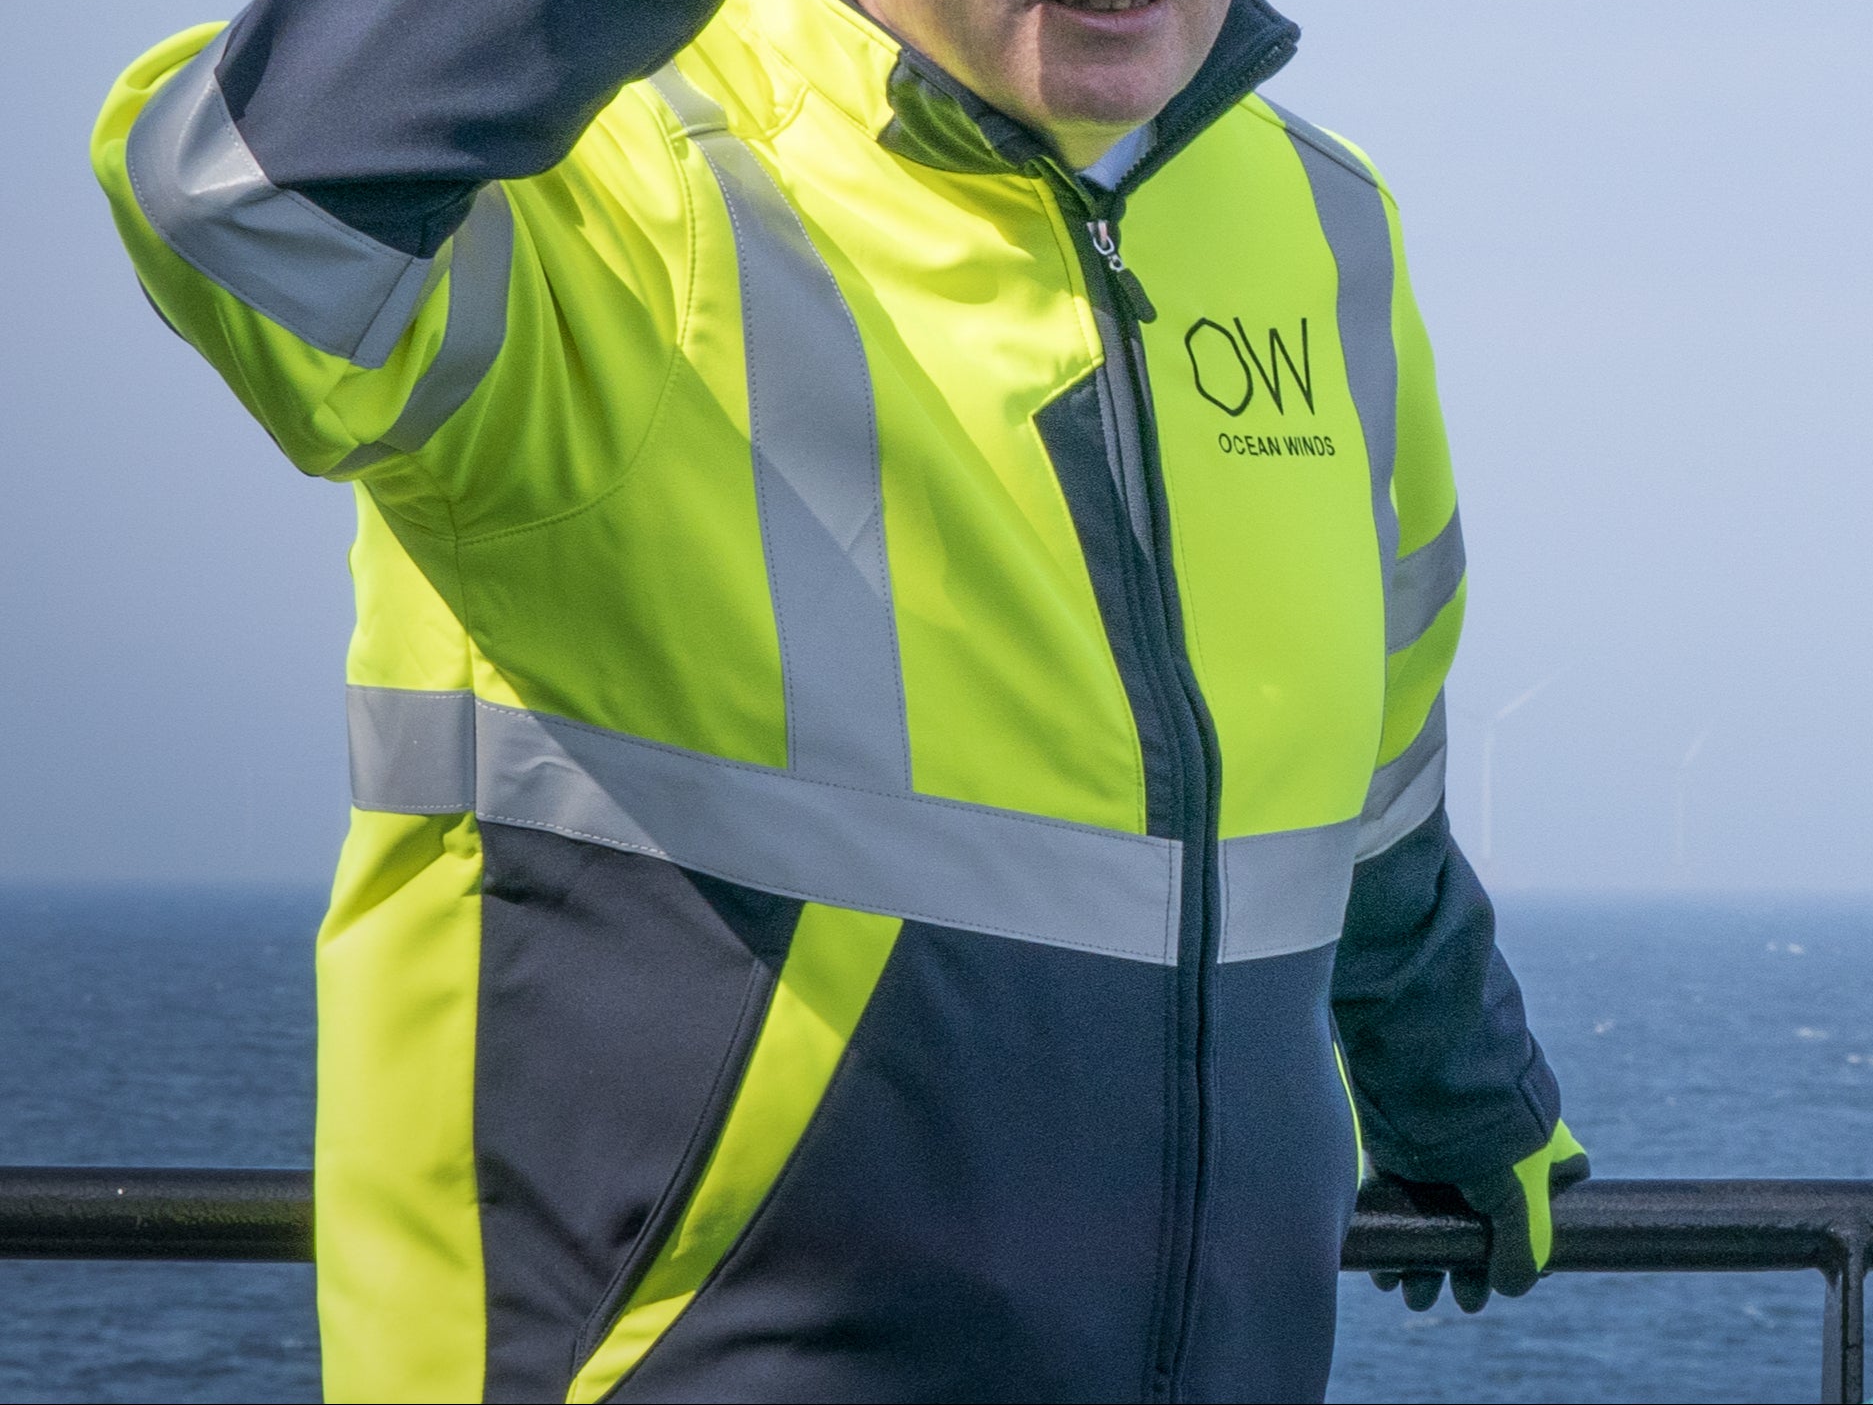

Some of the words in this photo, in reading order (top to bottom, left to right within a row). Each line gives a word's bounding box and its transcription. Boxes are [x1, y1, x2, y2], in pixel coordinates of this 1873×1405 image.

[1184, 316, 1315, 417] OW
[1218, 432, 1282, 456] OCEAN
[1283, 435, 1336, 457] WINDS
